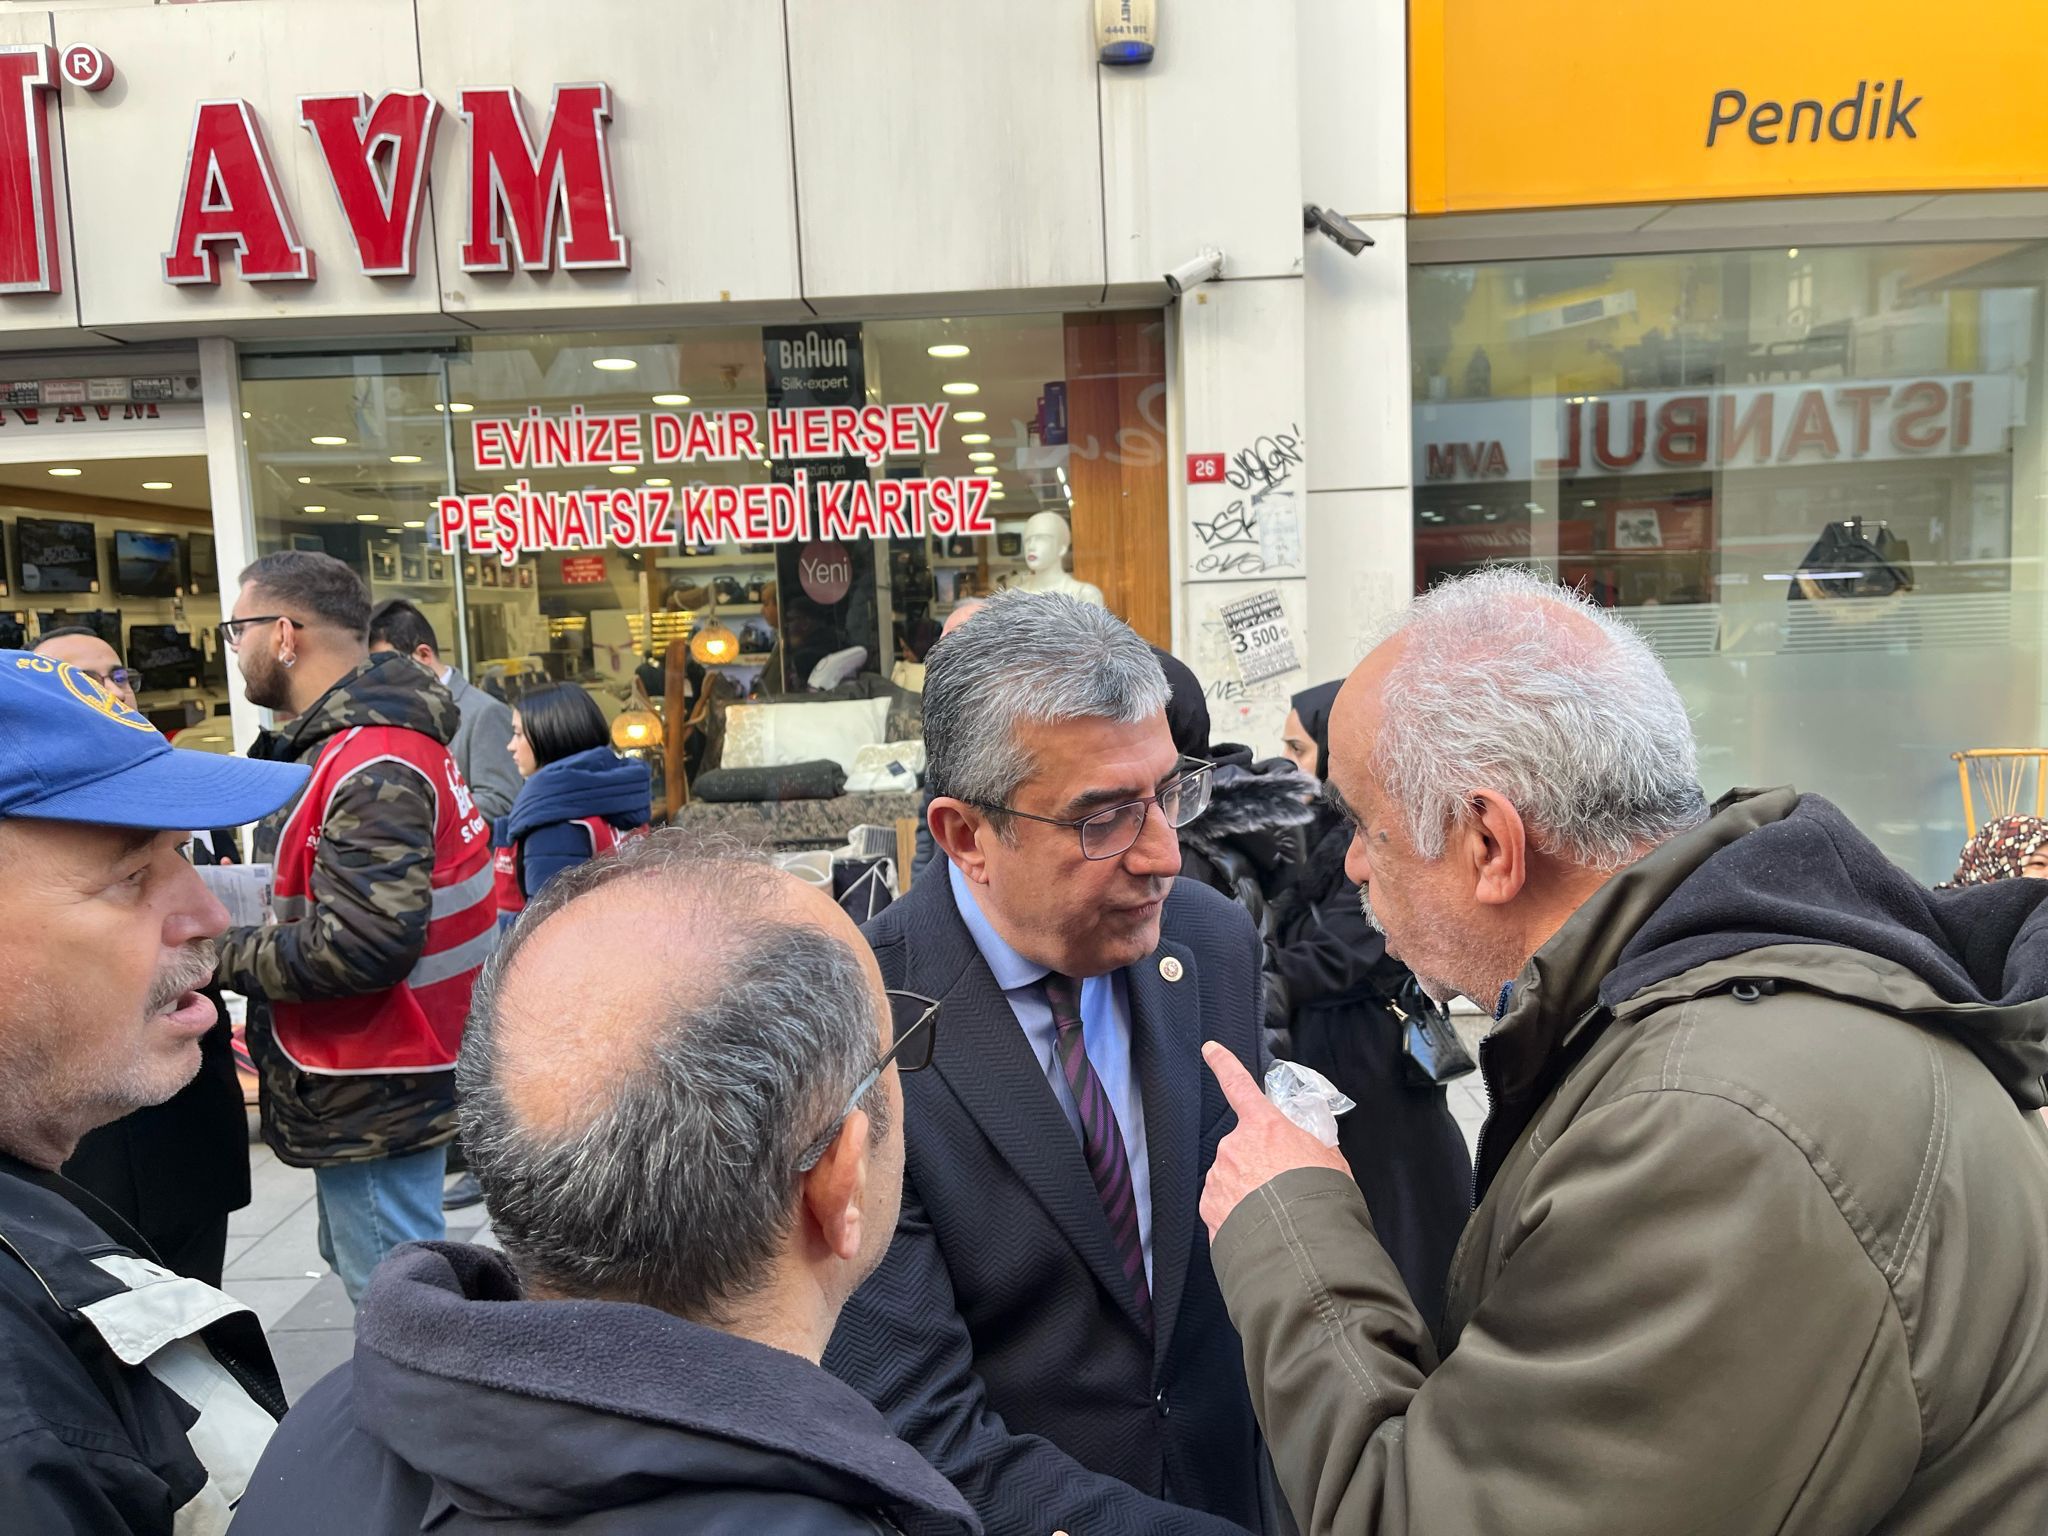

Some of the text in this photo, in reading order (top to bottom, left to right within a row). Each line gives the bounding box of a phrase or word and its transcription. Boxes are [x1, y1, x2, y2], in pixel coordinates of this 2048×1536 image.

[1705, 77, 1924, 148] Pendik
[161, 81, 631, 285] AVM
[779, 330, 848, 369] BRAUN
[472, 404, 643, 471] EVİNİZE
[768, 402, 949, 467] HERŞEY
[1195, 460, 1216, 477] 26
[438, 468, 996, 567] PEŞİNATSIZ KREDİ KARTSIZ
[801, 556, 848, 585] Yeni
